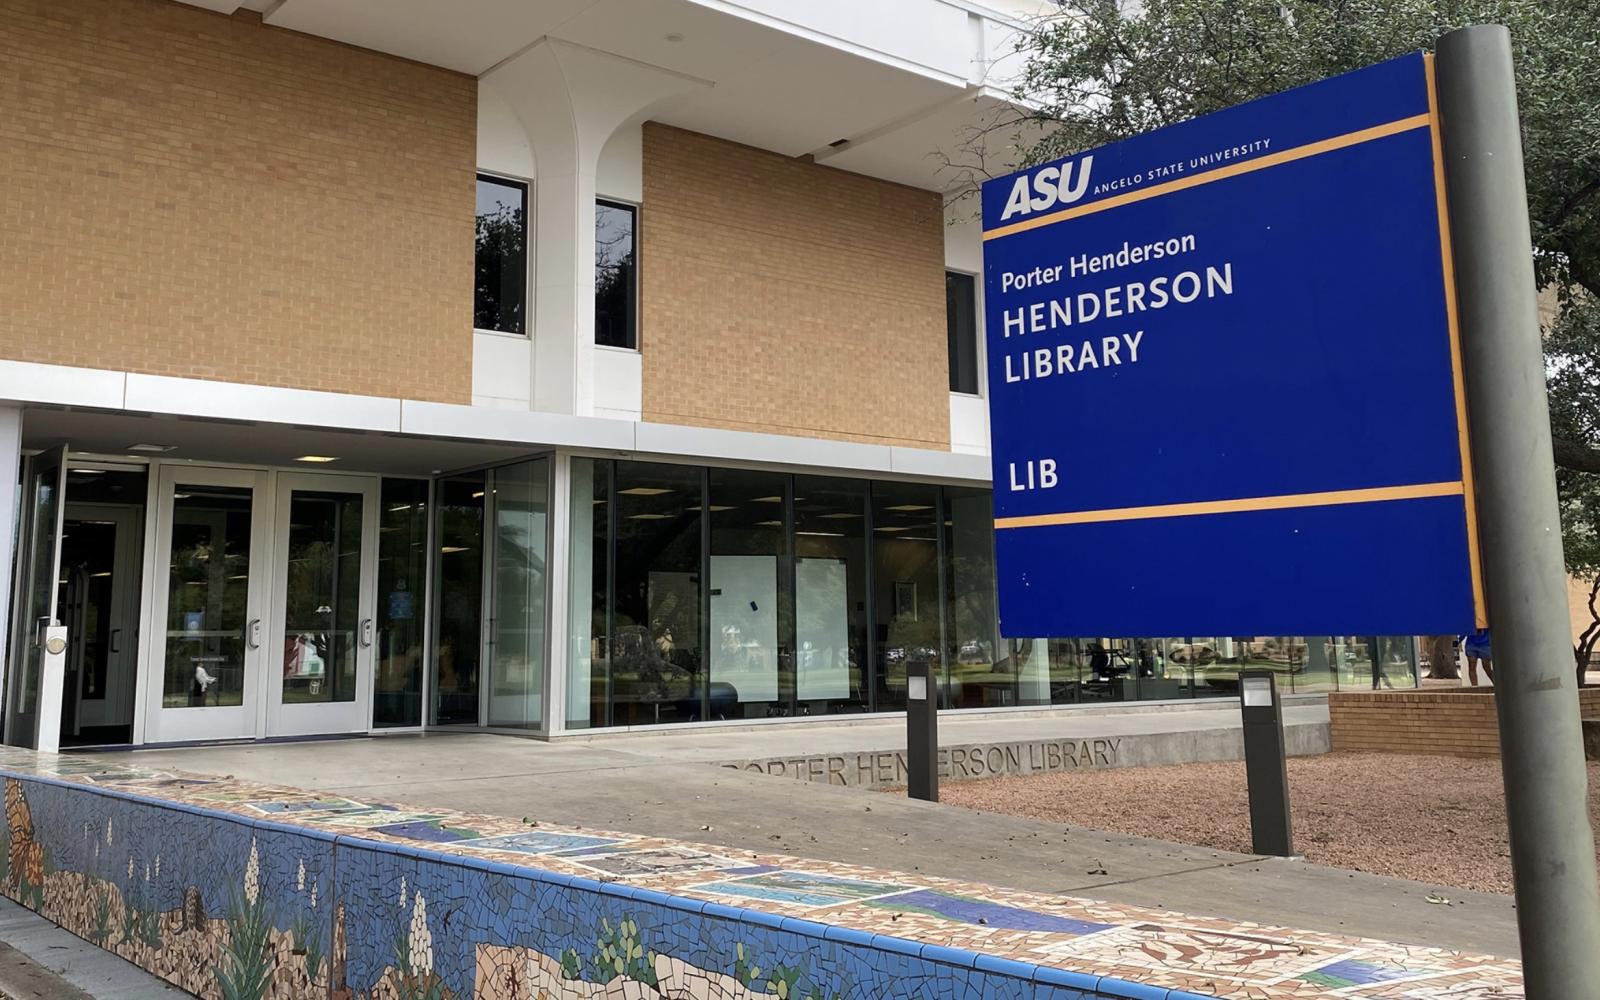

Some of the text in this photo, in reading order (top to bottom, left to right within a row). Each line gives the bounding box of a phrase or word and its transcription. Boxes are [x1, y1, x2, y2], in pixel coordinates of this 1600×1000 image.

[1000, 138, 1271, 221] ASU ANGELO STATE UNIVERSITY
[1001, 234, 1196, 293] Porter Henderson
[1003, 262, 1234, 338] HENDERSON
[1005, 330, 1144, 383] LIBRARY
[1009, 458, 1058, 491] LIB
[857, 744, 1020, 784] HENERSON
[1029, 738, 1121, 771] LIBRARY
